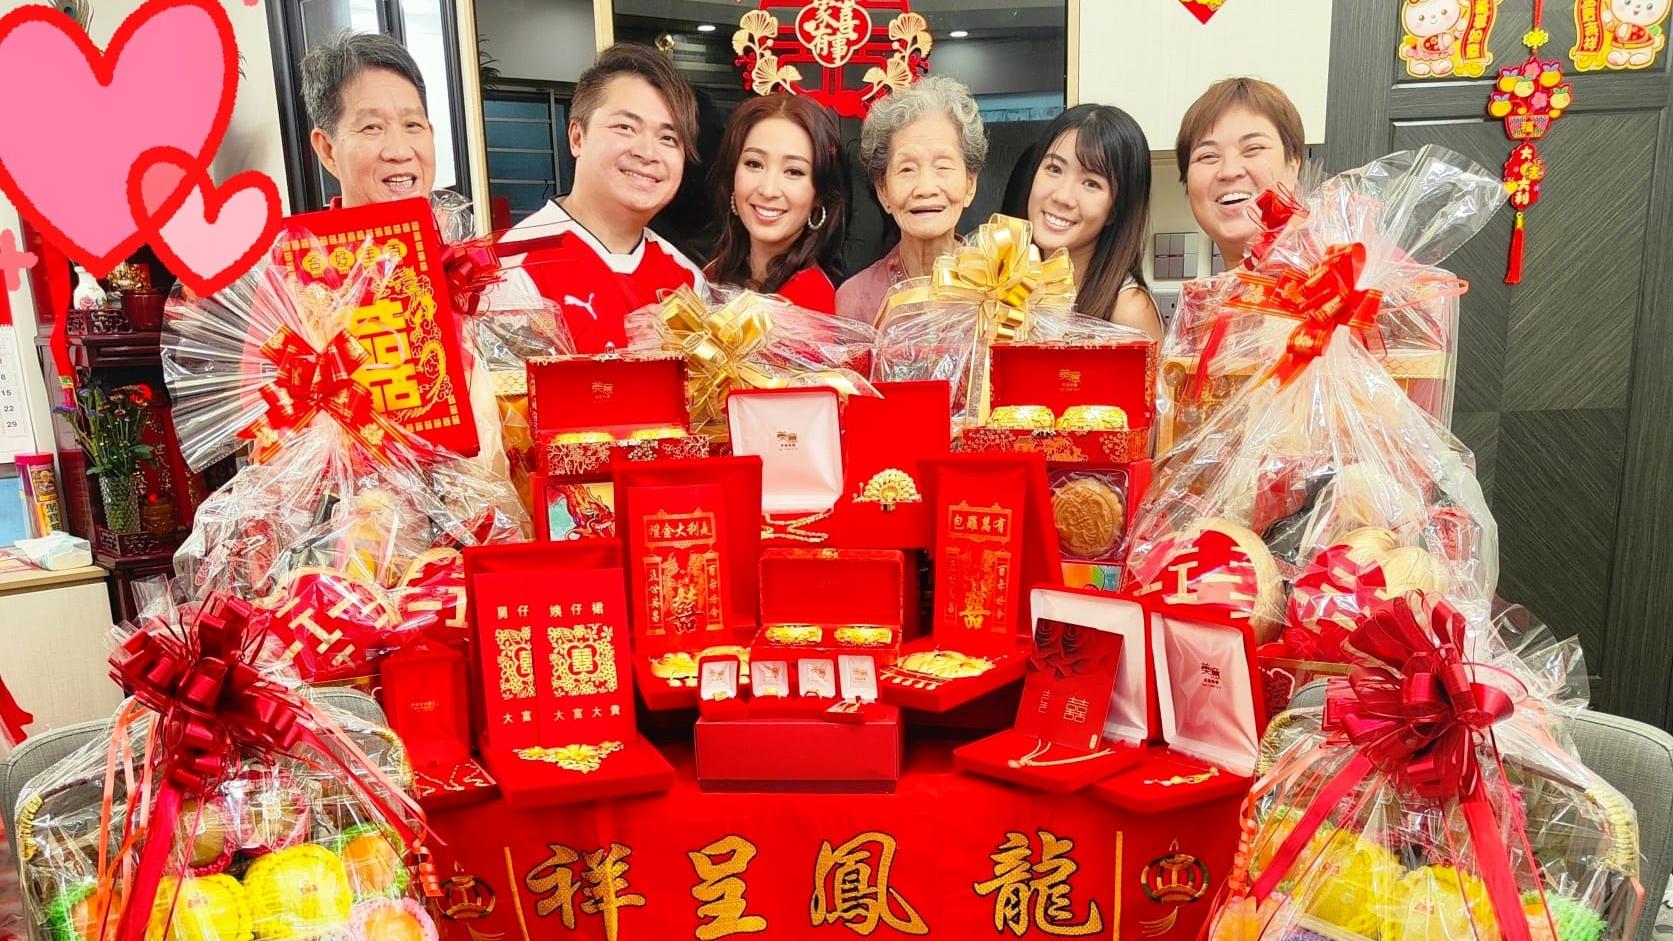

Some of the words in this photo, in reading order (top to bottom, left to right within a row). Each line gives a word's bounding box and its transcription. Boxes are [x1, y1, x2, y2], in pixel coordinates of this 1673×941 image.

[1514, 146, 1541, 205] 大吉大利
[554, 704, 621, 721] 大富大貴
[1063, 696, 1089, 723] 囍
